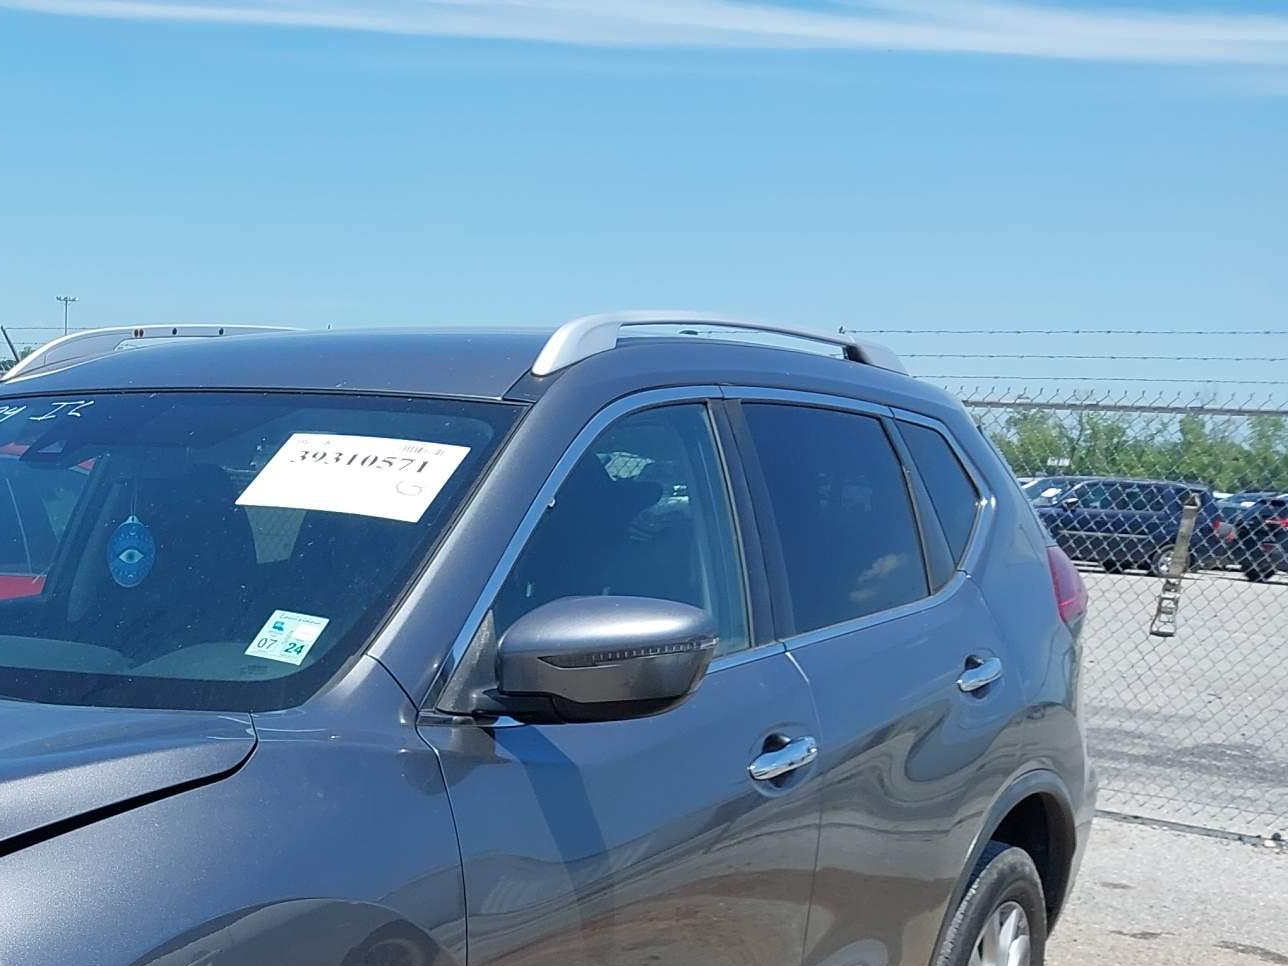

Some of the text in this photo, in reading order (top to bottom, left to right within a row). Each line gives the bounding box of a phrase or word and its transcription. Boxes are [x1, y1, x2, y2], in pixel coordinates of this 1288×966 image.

[289, 450, 429, 473] 39310571
[257, 637, 278, 650] 07
[284, 642, 305, 655] 24
